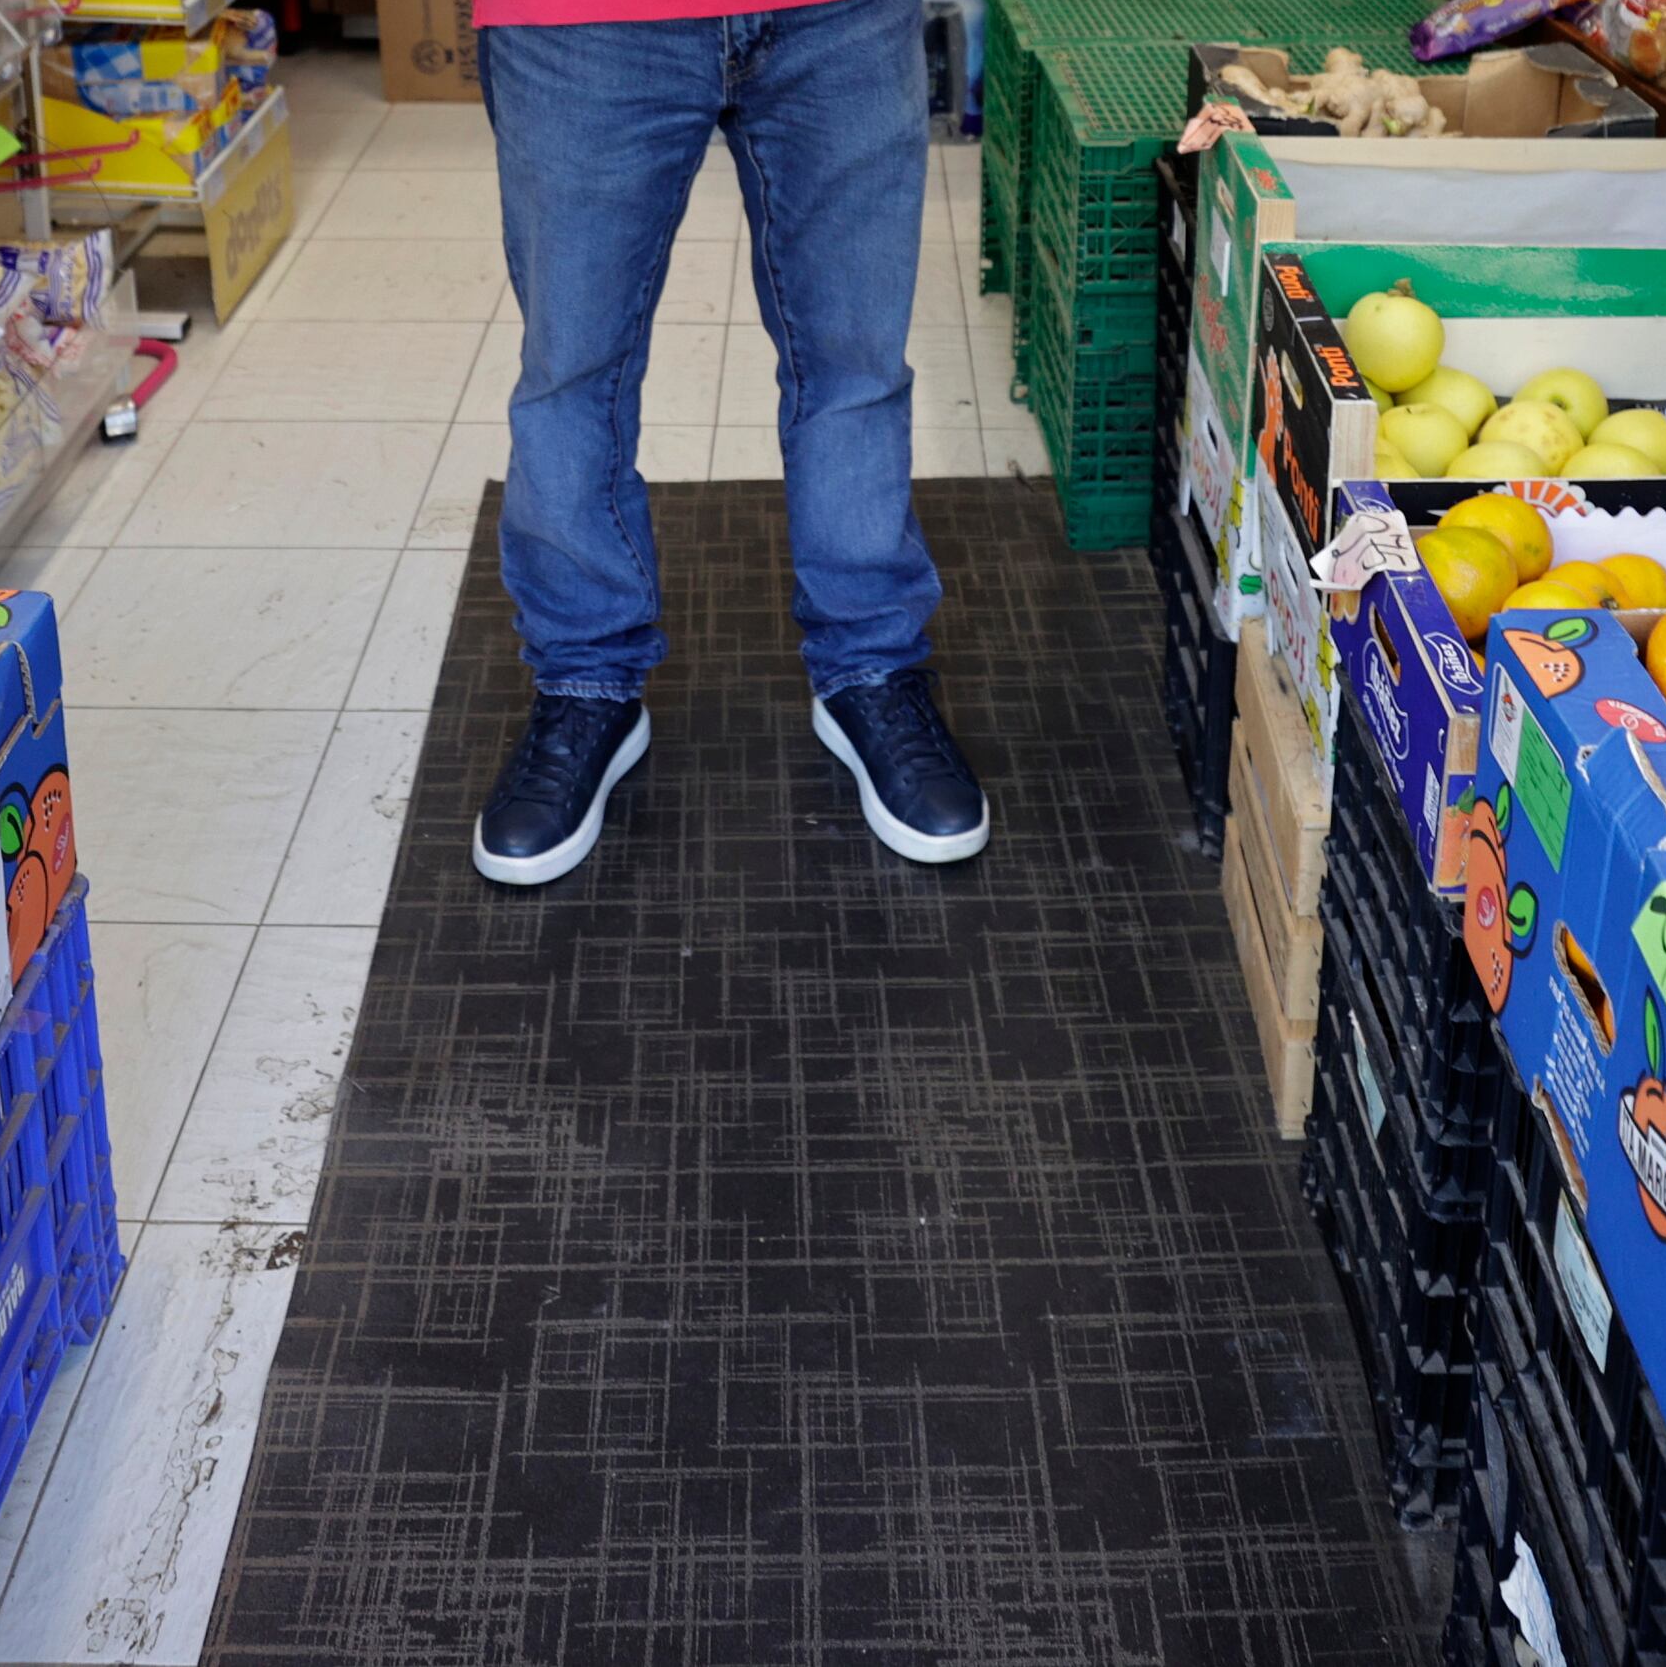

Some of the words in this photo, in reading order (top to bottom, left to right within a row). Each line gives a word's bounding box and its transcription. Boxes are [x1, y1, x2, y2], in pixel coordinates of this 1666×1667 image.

[1273, 264, 1315, 302] Ponti
[1314, 343, 1361, 388] Ponti
[1283, 426, 1321, 543] Ponti
